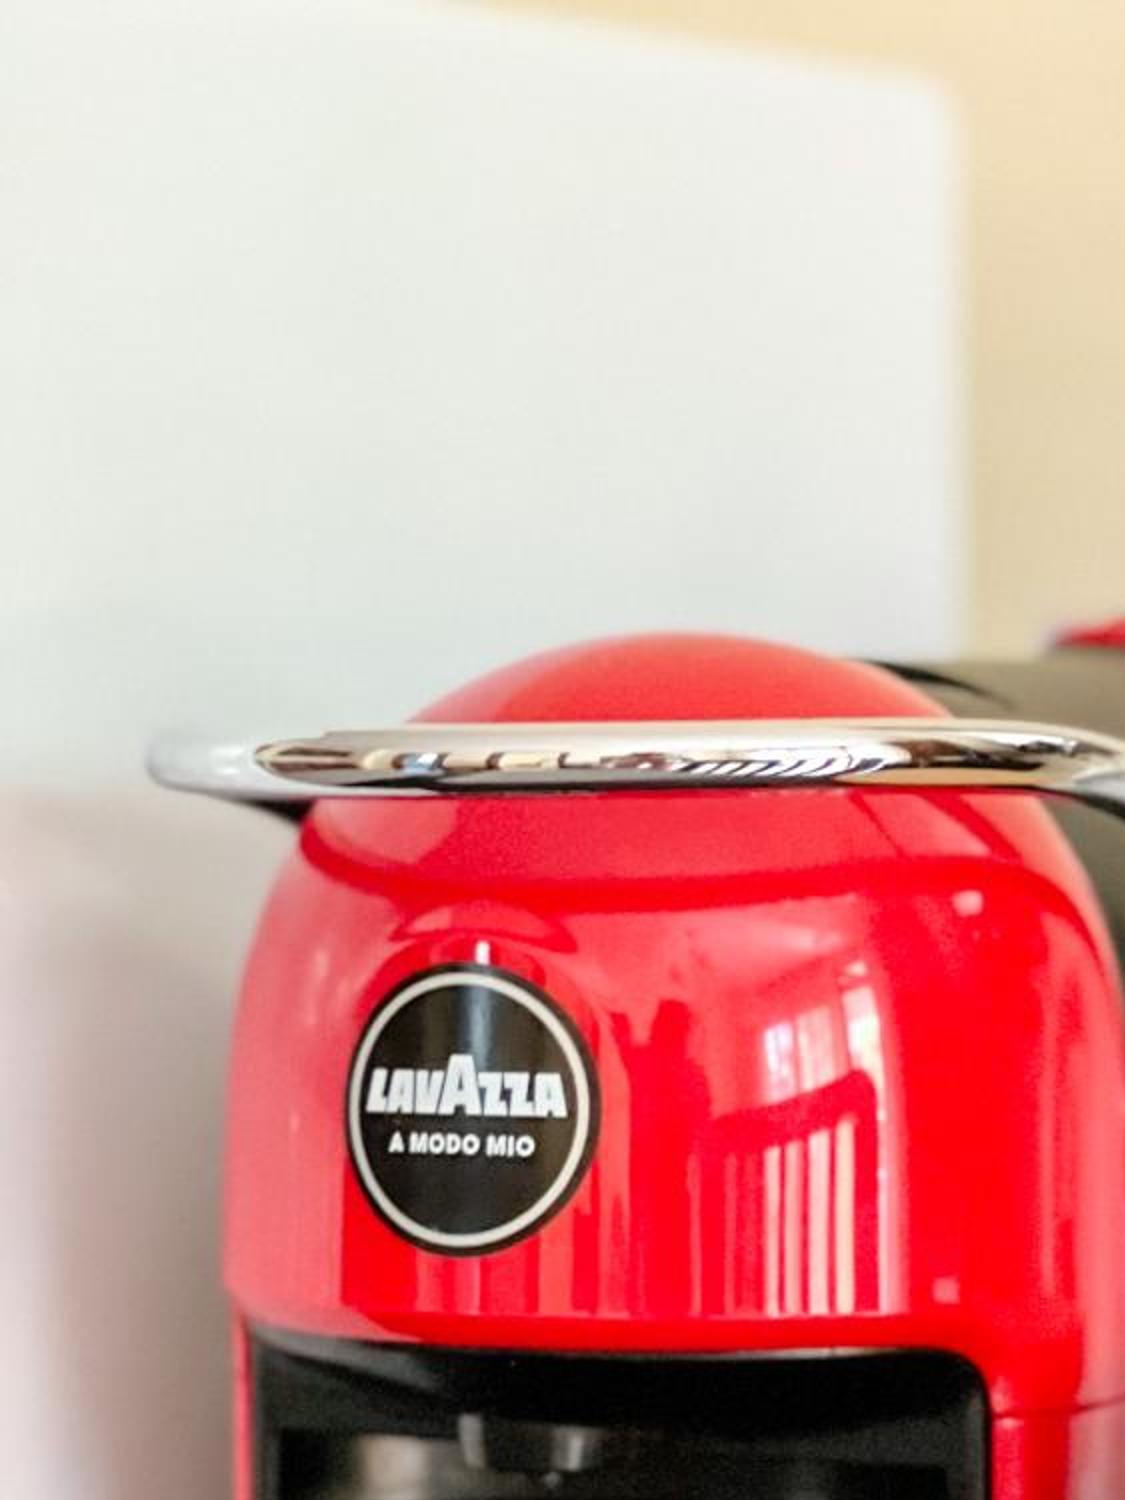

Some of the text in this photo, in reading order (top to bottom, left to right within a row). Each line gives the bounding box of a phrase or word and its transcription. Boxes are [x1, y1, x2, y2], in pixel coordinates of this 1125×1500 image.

[366, 1053, 568, 1119] LAVAZZA
[388, 1131, 536, 1158] A MODO MIO
